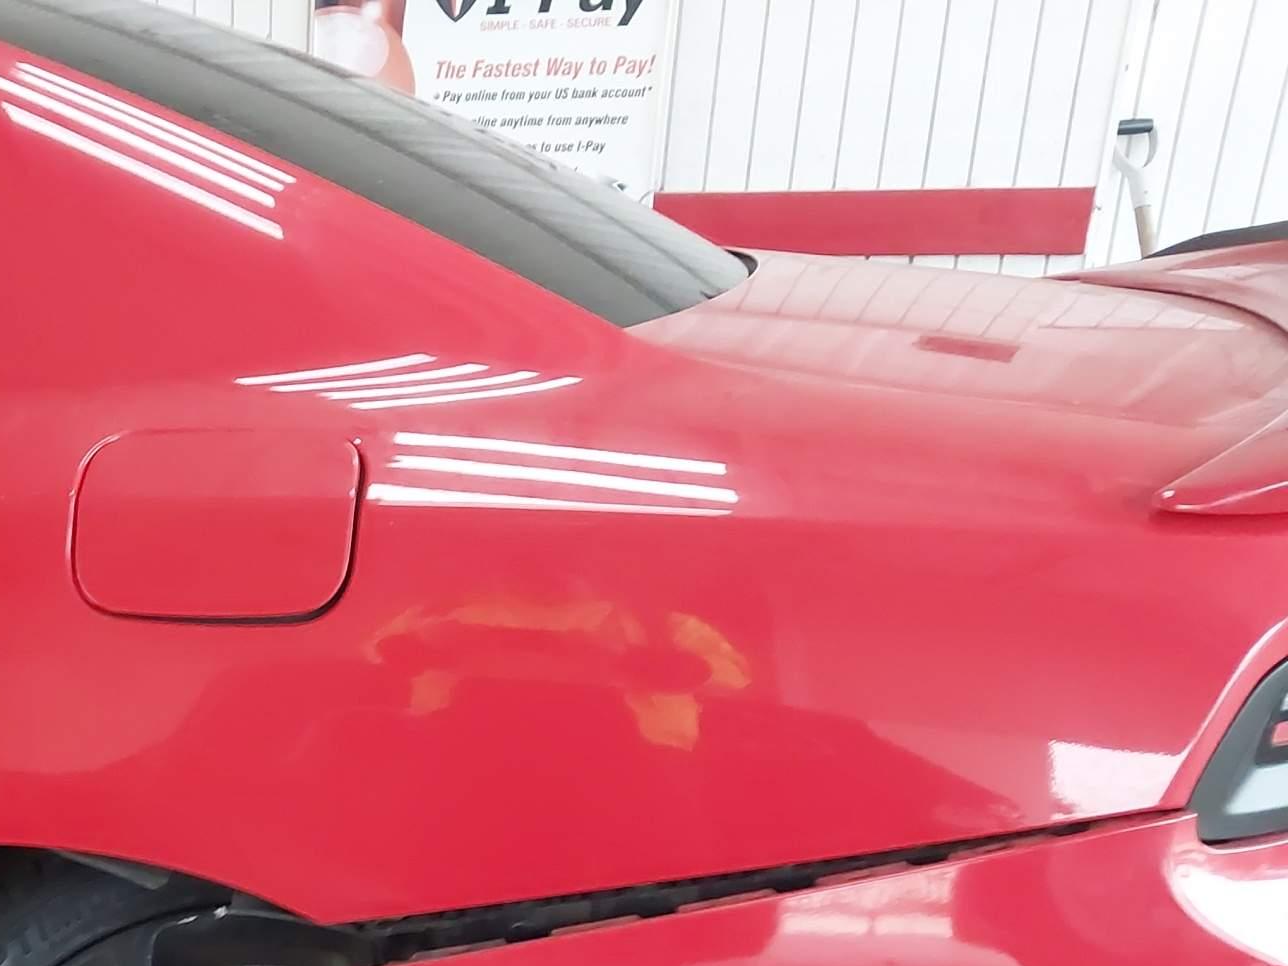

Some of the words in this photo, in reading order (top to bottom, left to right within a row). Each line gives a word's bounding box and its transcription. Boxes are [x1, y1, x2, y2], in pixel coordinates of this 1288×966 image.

[480, 19, 520, 31] SIMPLE
[529, 18, 556, 30] SAFE
[567, 17, 611, 28] SECURE
[436, 61, 466, 80] The
[472, 58, 540, 78] Fastest
[546, 57, 584, 80] Way
[589, 57, 607, 76] to
[613, 55, 656, 79] Pay!
[442, 90, 463, 104] Pay
[465, 89, 498, 102] online
[500, 89, 526, 101] from
[527, 89, 552, 103] your
[555, 88, 569, 99] US
[572, 87, 598, 99] bank
[500, 115, 543, 129] anytime
[547, 114, 572, 126] from
[575, 114, 629, 128] anywhere
[540, 141, 551, 153] to
[554, 143, 573, 152] use
[576, 140, 606, 154] I-Pay
